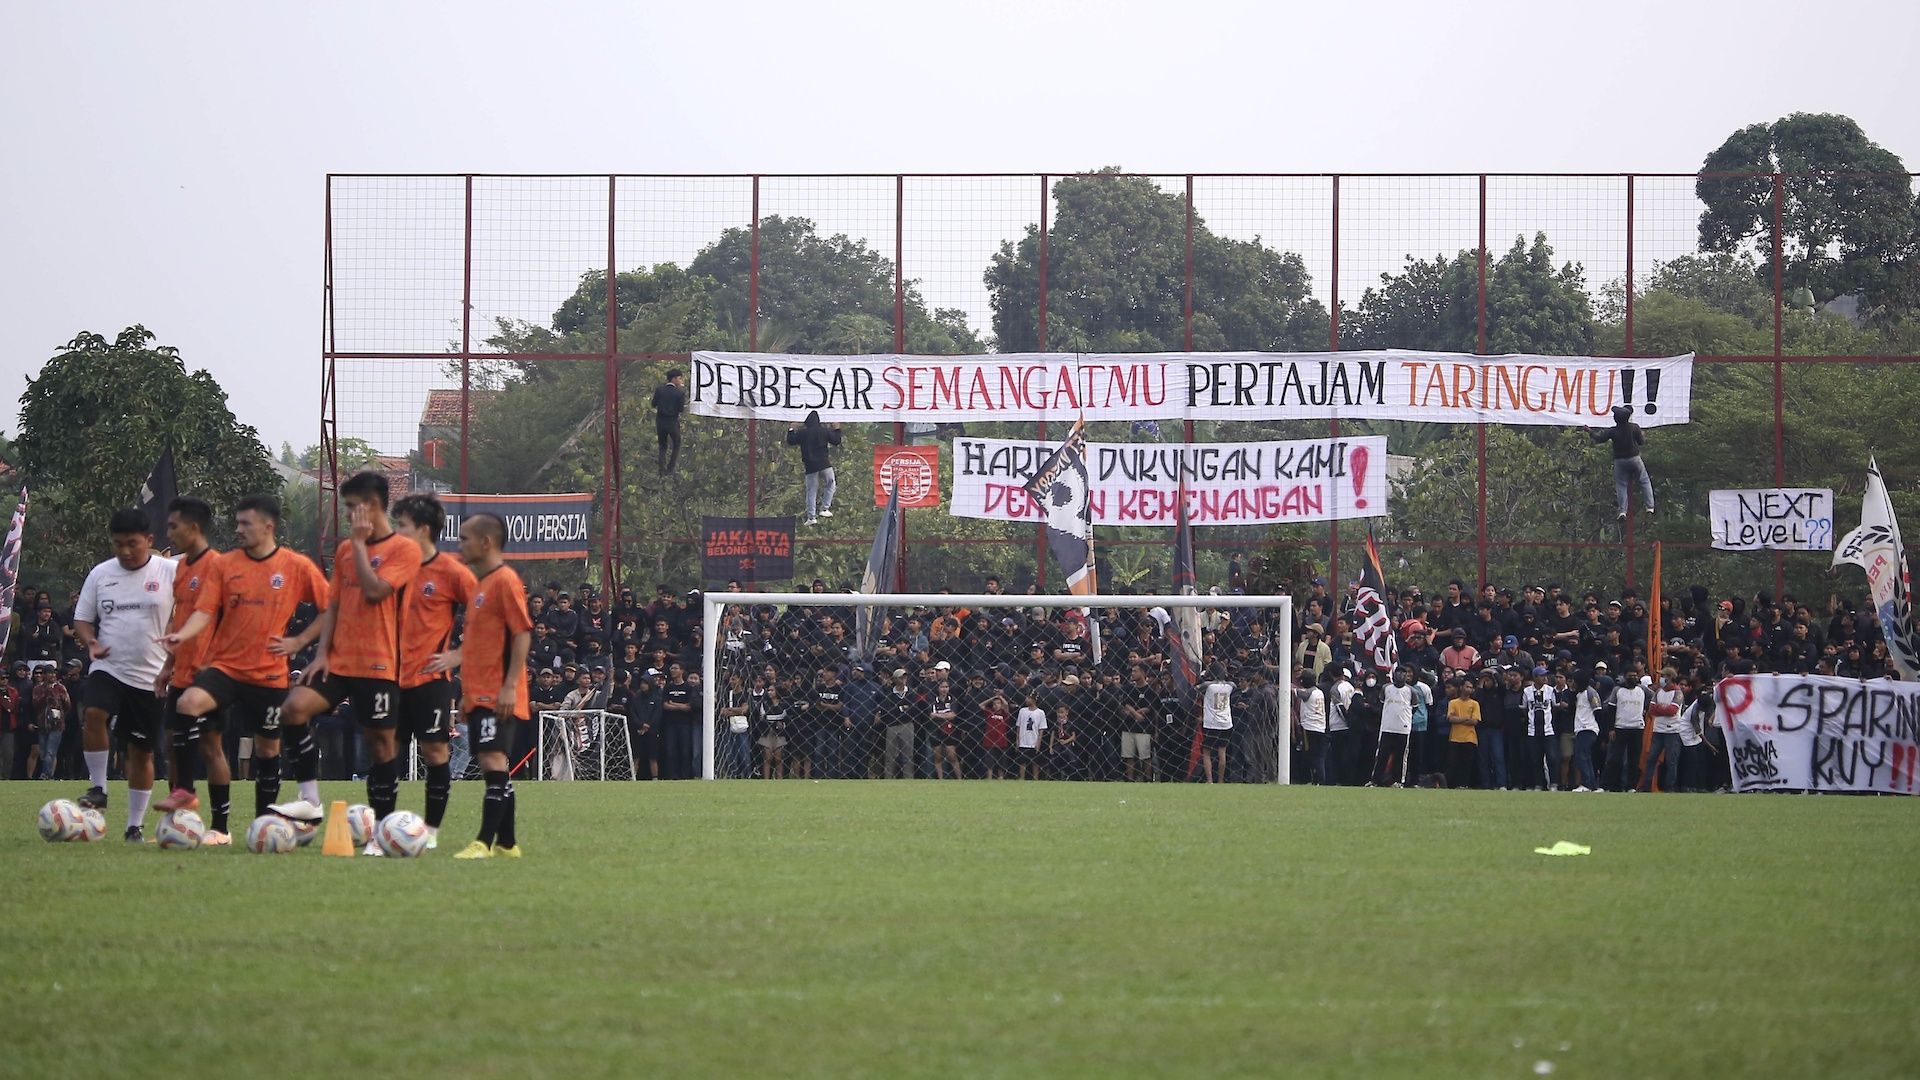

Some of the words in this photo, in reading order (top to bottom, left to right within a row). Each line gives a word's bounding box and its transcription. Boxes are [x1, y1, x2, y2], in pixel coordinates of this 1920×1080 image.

[694, 359, 873, 410] PERBESAR
[882, 364, 1167, 411] SEMANGATMU
[1186, 361, 1384, 406] PERTAJAM
[1099, 448, 1260, 482] DUKUNGAN
[1275, 442, 1348, 479] KAMI
[984, 483, 1106, 520] DENN
[1738, 492, 1823, 523] NEXT
[505, 515, 533, 542] YOU
[537, 514, 588, 541] PERSIJA
[706, 530, 790, 547] JAKARTA
[757, 546, 772, 555] TO
[774, 547, 789, 557] ME
[374, 692, 389, 712] 21
[266, 706, 281, 725] 22
[434, 709, 441, 727] 7
